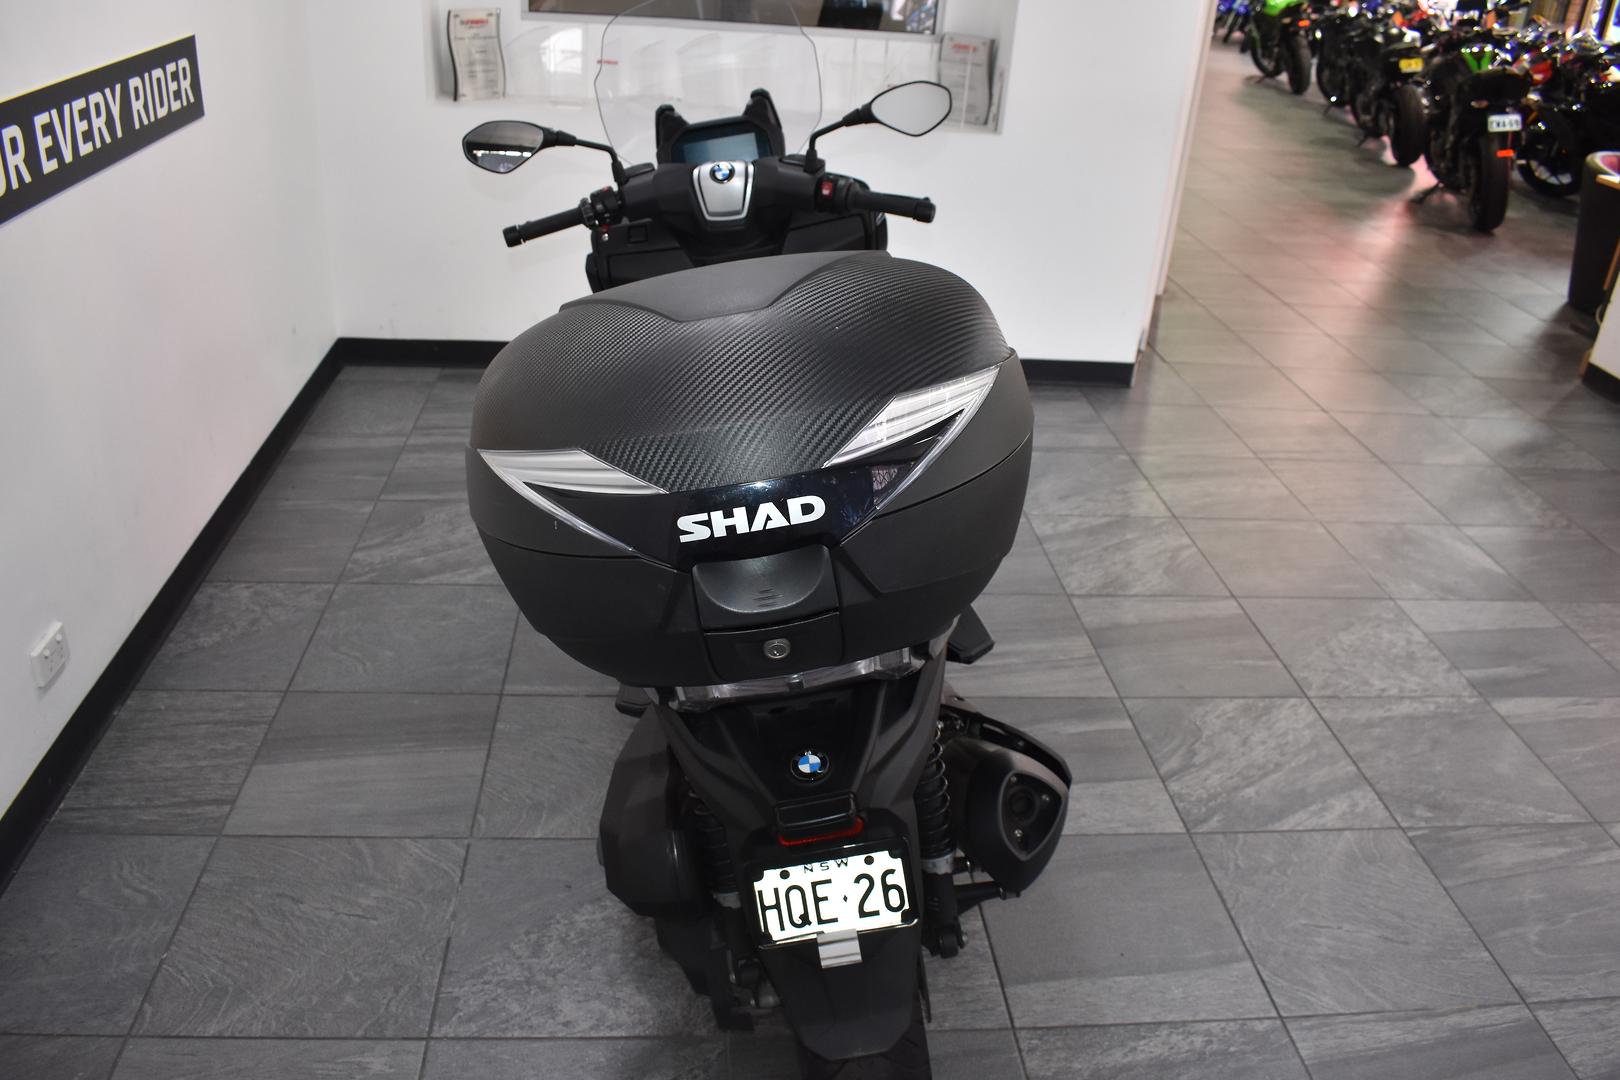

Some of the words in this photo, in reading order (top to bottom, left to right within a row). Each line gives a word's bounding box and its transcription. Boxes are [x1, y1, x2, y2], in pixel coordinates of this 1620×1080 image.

[0, 124, 31, 198] R
[34, 83, 121, 175] EVERY
[128, 57, 195, 130] RIDER
[676, 495, 826, 543] SHAD
[803, 857, 849, 874] NSW
